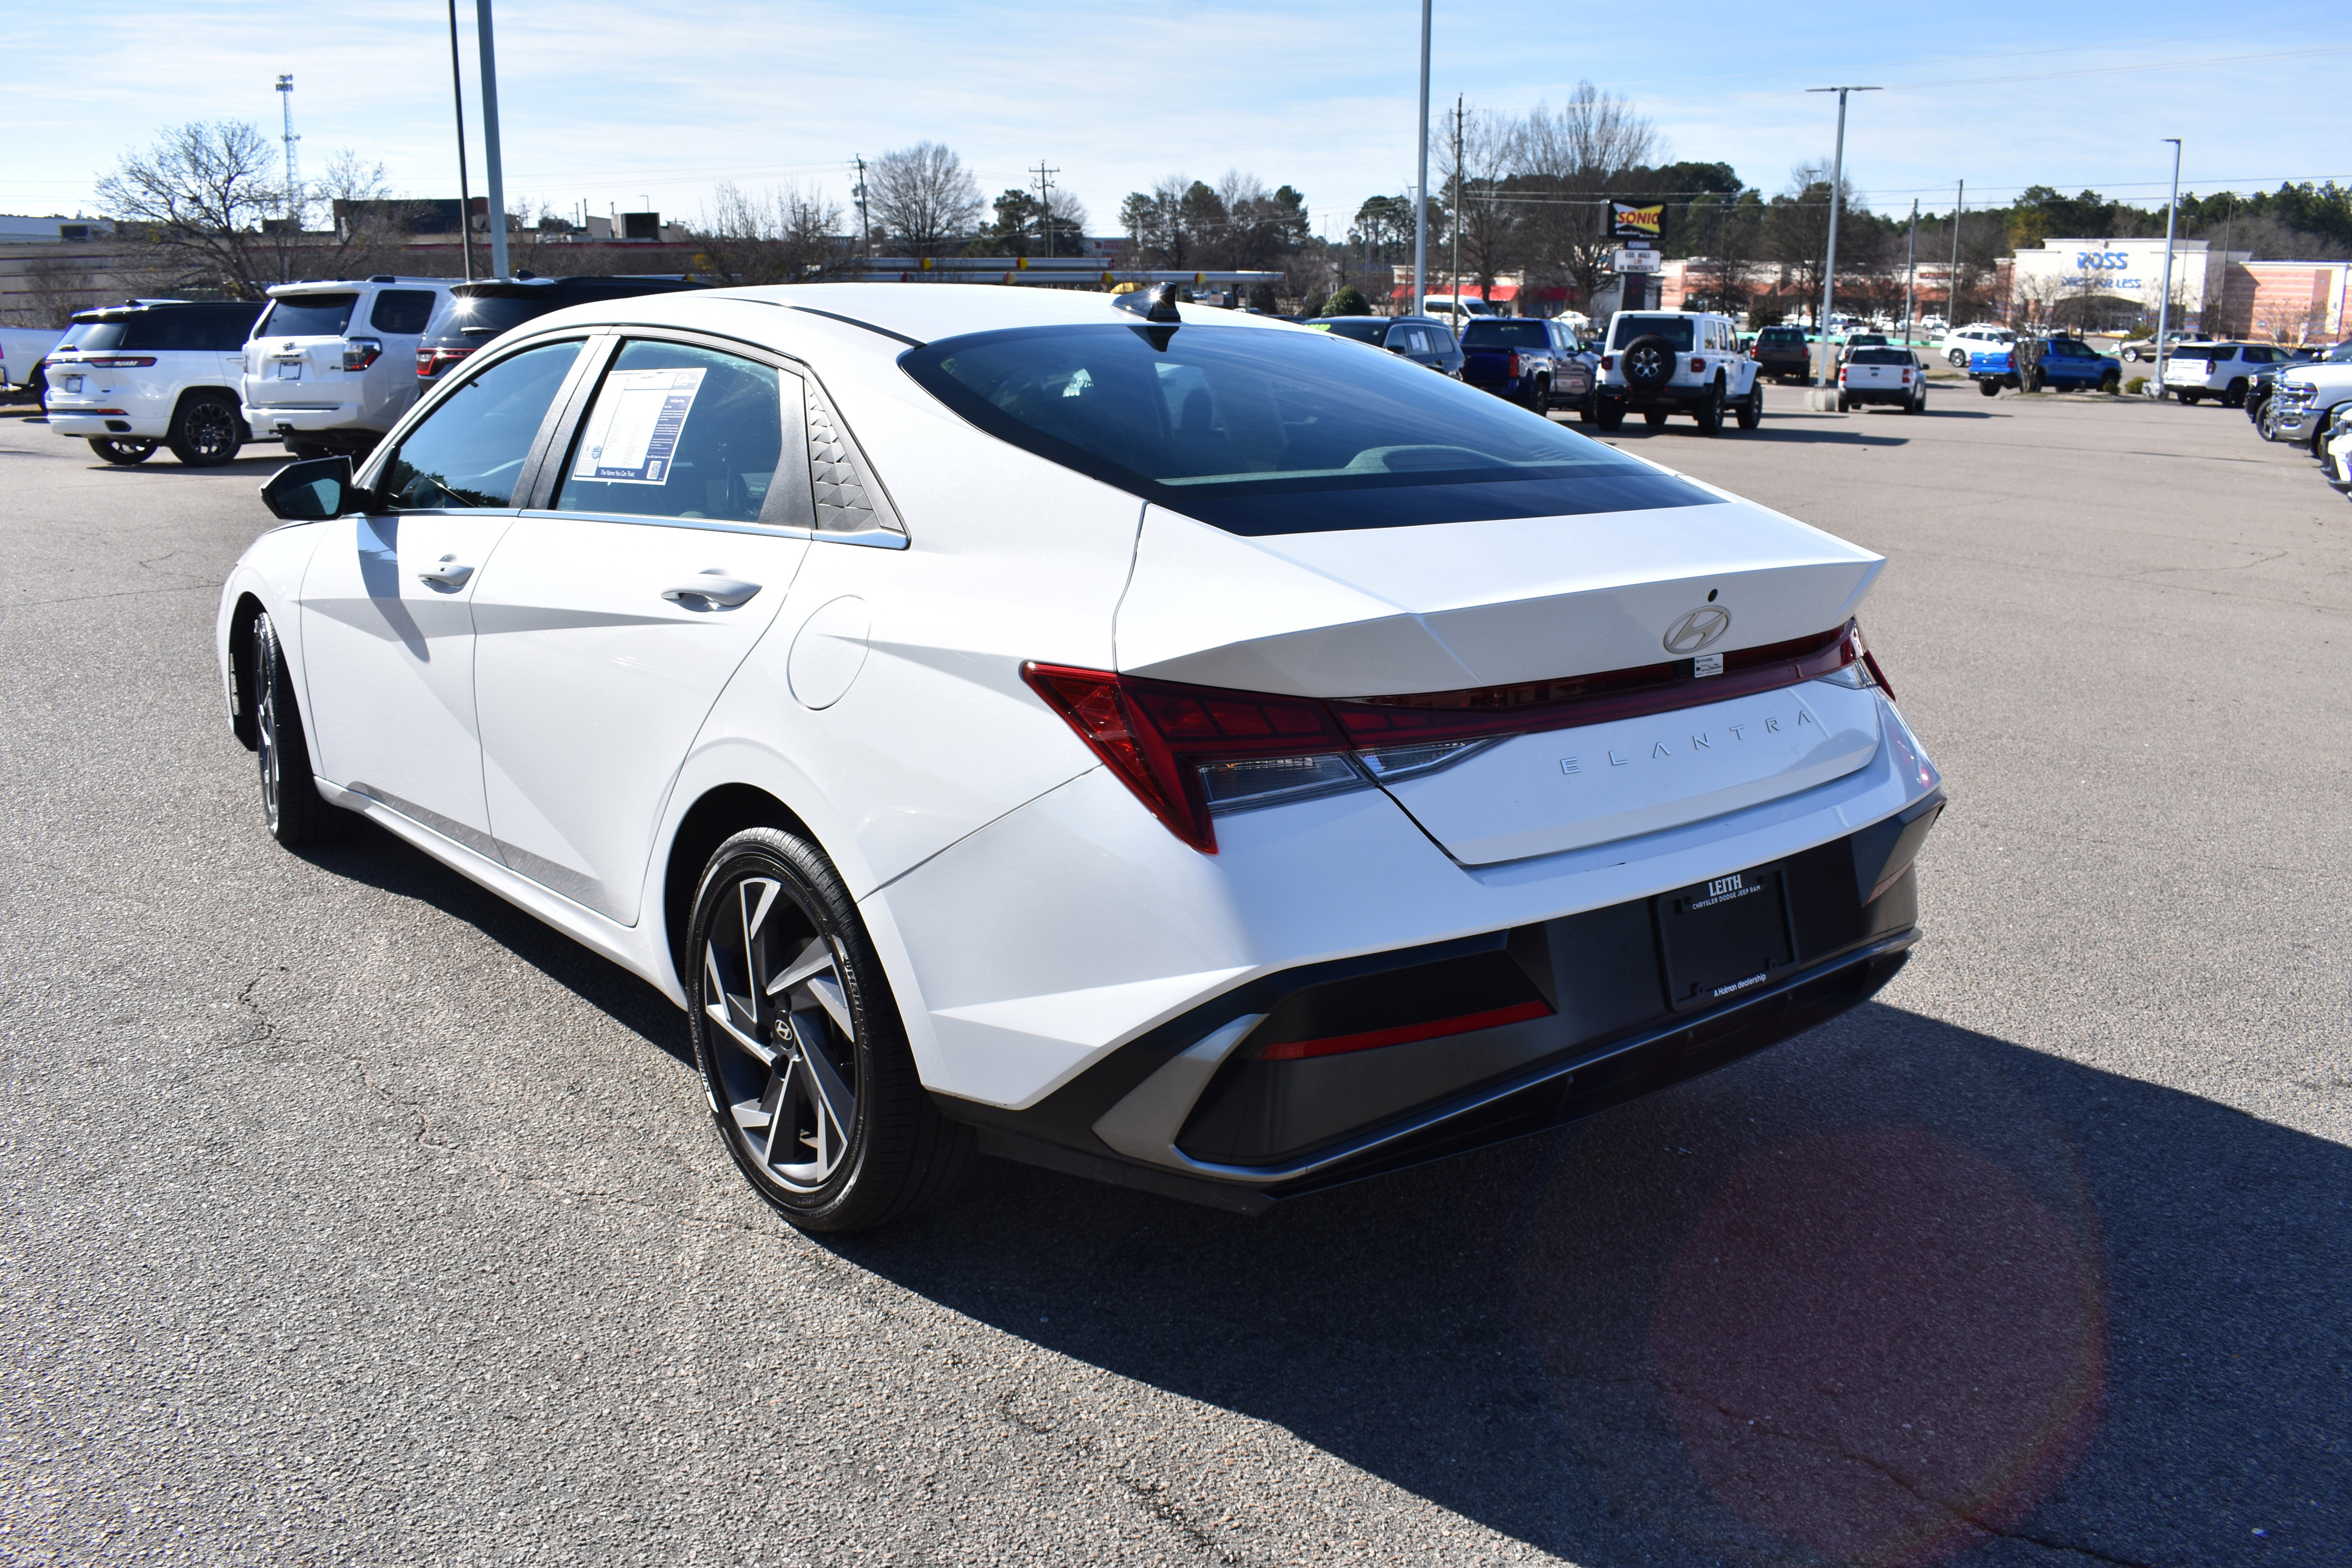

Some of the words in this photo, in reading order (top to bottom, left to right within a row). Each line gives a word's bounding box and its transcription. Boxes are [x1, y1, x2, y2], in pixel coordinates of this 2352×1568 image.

[1618, 212, 1659, 224] SONIC
[2077, 252, 2128, 270] ROSS
[2116, 279, 2141, 288] LESS
[1560, 710, 1811, 774] ELANTRA
[1708, 874, 1742, 897] LEITH
[1693, 898, 1718, 910] CHRYSLER
[1719, 892, 1737, 902] DODGE
[1737, 888, 1749, 897] JEEP
[1718, 984, 1737, 996] Holman
[1737, 973, 1766, 989] dealership
